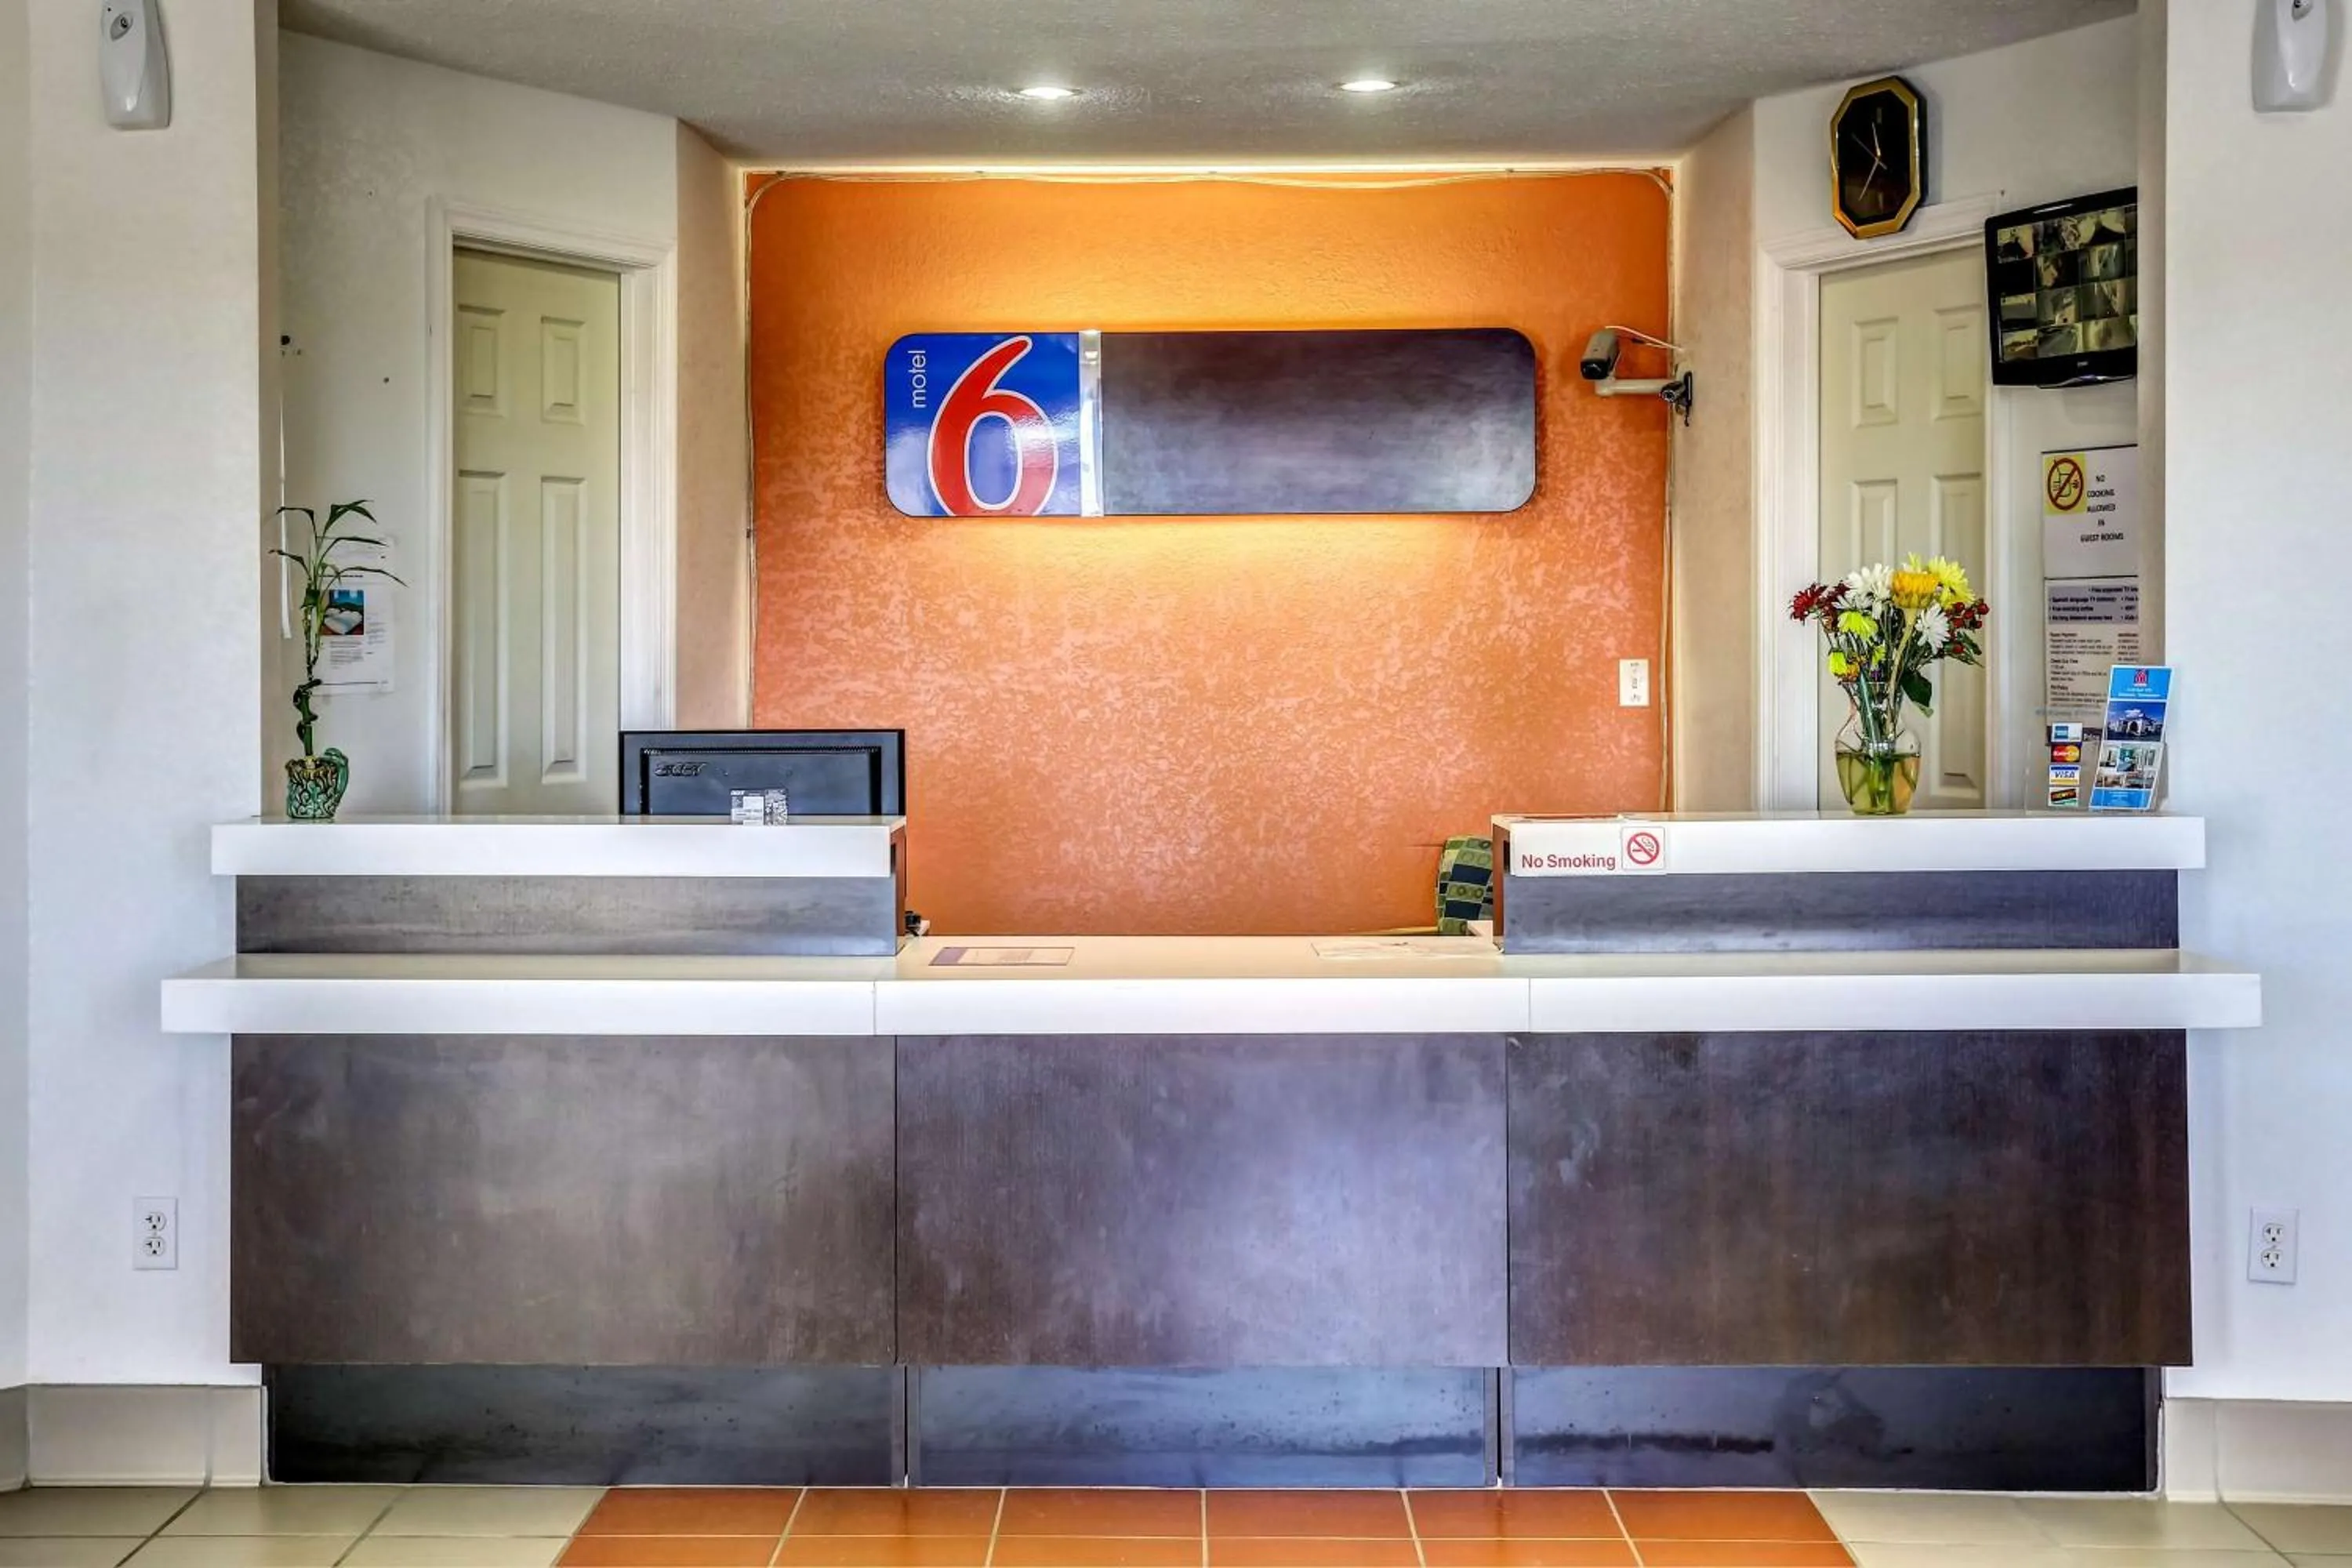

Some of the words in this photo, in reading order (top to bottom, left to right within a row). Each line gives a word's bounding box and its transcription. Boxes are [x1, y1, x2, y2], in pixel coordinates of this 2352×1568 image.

[908, 350, 926, 408] motel
[927, 335, 1058, 516] 6
[2087, 488, 2115, 497] COOKING
[2087, 503, 2116, 513] ALLOWED
[2080, 534, 2099, 543] GUEST
[2100, 532, 2124, 541] ROOMS
[1521, 854, 1544, 868] No
[1547, 854, 1616, 871] Smoking
